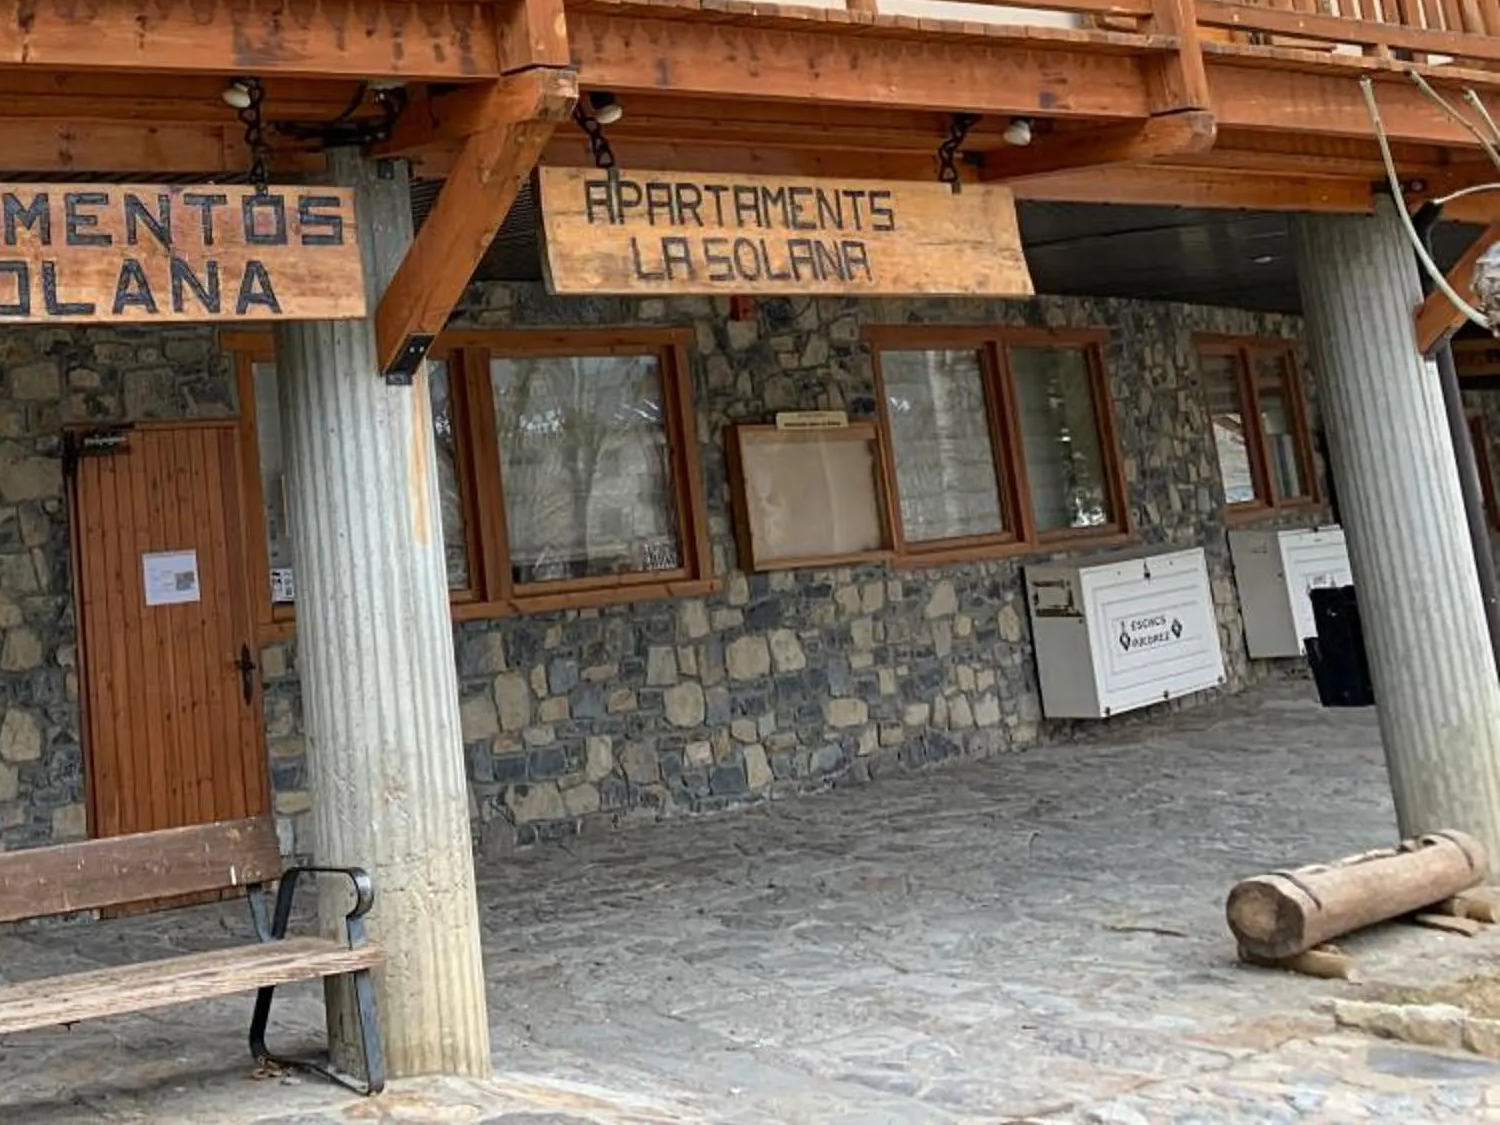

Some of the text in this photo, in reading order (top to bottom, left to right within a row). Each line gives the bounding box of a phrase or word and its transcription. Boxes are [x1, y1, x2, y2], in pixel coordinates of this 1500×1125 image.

[583, 179, 896, 232] APARTAMENTS
[630, 236, 873, 282] LA SOLANA
